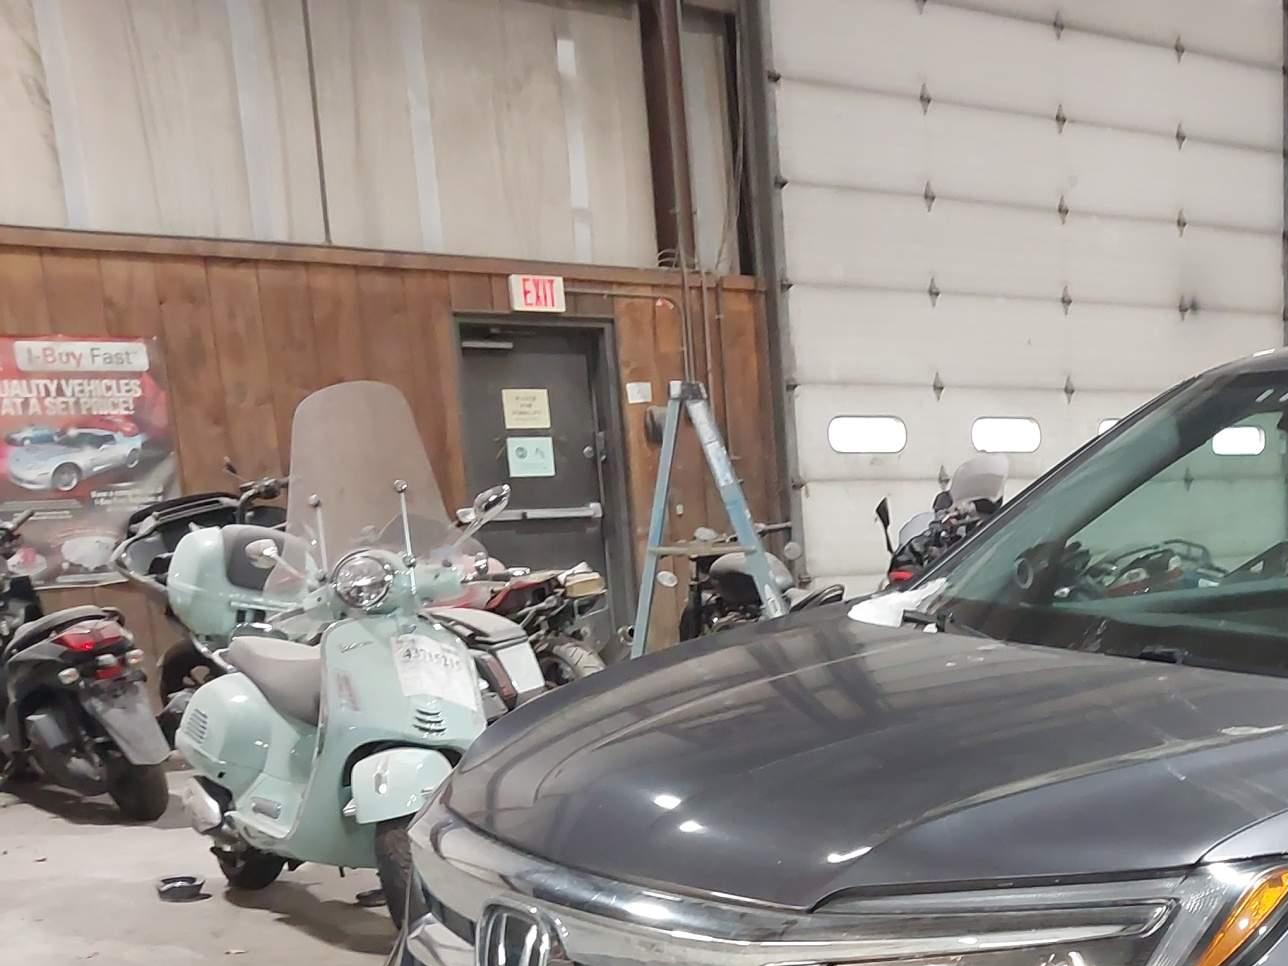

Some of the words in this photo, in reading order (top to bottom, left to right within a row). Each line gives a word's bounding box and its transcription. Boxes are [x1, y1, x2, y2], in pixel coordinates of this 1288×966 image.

[521, 277, 556, 308] EXIT
[27, 347, 83, 368] I-Buy
[90, 347, 135, 366] Fast
[0, 379, 58, 398] UALITY
[61, 379, 142, 398] VEHICLES
[1, 398, 25, 415] AT
[28, 398, 43, 415] A
[45, 398, 76, 415] SET
[79, 397, 136, 415] PRICE!
